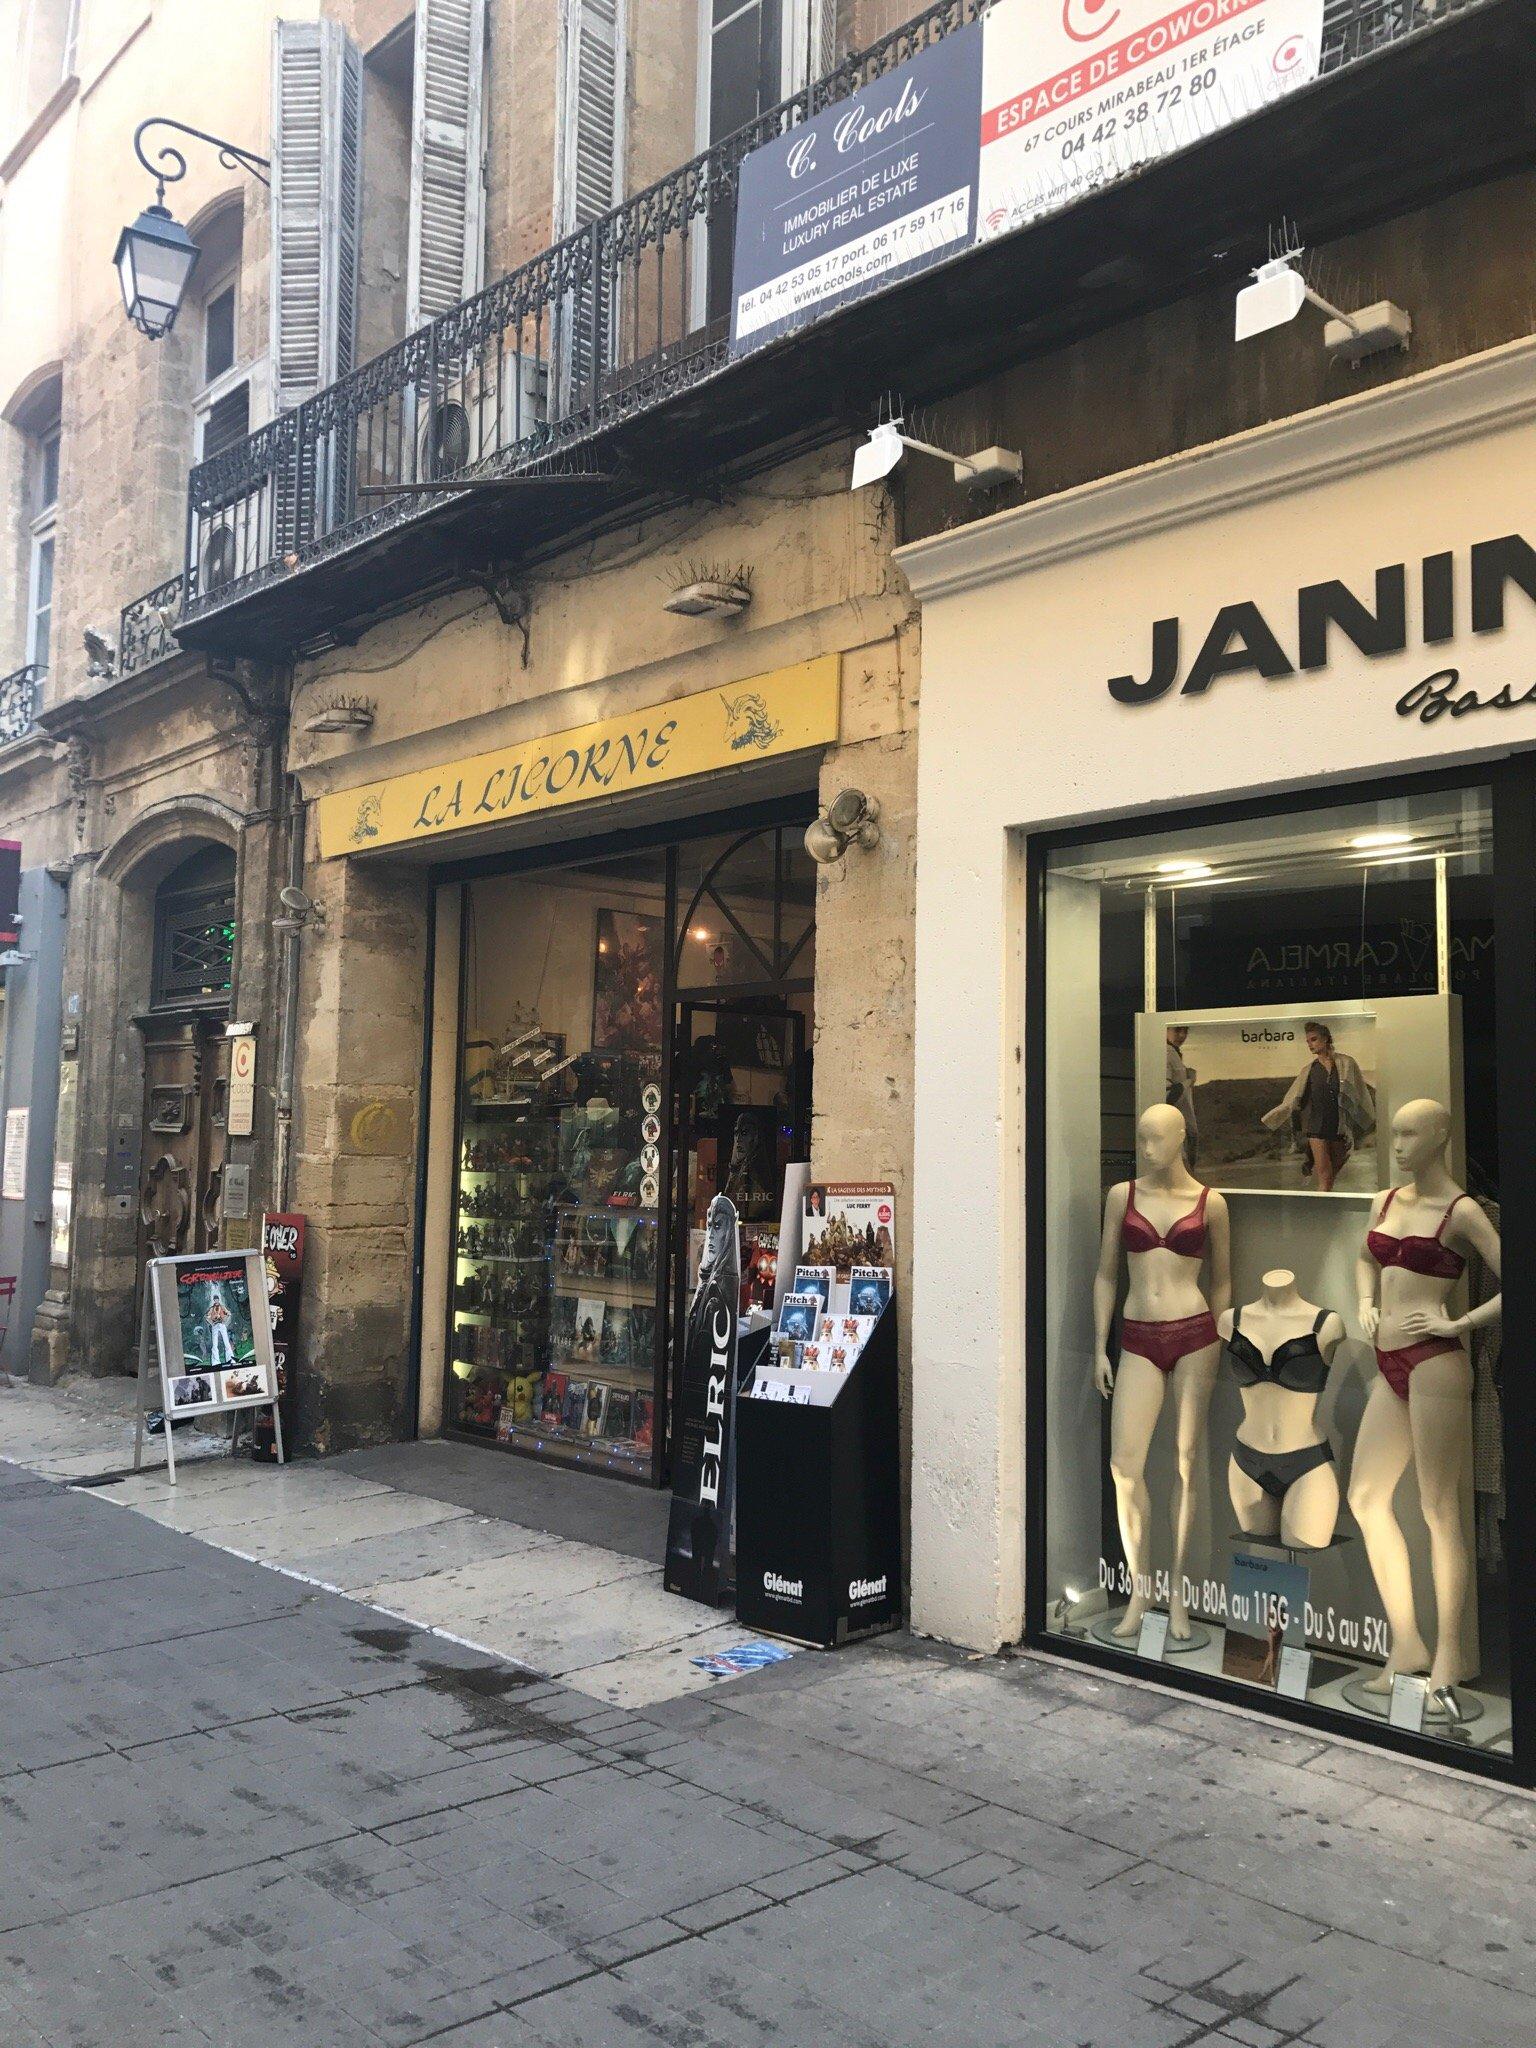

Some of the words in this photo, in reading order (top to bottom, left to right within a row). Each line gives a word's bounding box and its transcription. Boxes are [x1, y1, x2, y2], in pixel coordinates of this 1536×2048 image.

[997, 73, 1082, 132] ESPACE
[1089, 53, 1118, 81] DE
[1024, 133, 1040, 153] 67
[1044, 108, 1094, 142] COURS
[1097, 67, 1176, 117] MIRABEAU
[1181, 50, 1208, 74] 1ER
[1213, 18, 1265, 57] ÉTAGE
[1061, 137, 1085, 160] 04
[1091, 118, 1117, 143] 42
[1123, 101, 1149, 126] 38
[1156, 84, 1182, 113] 72
[1189, 67, 1217, 97] 80
[787, 133, 817, 179] C.
[834, 77, 928, 153] Cools
[783, 220, 829, 255] LUXURY
[833, 205, 865, 230] REAL
[868, 176, 918, 212] ESTATE
[784, 185, 857, 235] IMMOBILIER
[861, 178, 880, 195] DE
[883, 153, 919, 183] LUXE
[1048, 181, 1068, 199] WIFI
[741, 297, 757, 313] tél.
[760, 291, 772, 305] 04
[775, 281, 788, 298] 42
[791, 273, 804, 288] 53
[807, 266, 821, 281] 05
[825, 257, 839, 272] 17
[841, 245, 869, 268] port.
[873, 236, 888, 251] 06
[892, 225, 905, 241] 17
[909, 216, 925, 233] 59
[930, 206, 945, 222] 17
[950, 197, 965, 212] 16
[793, 251, 892, 306] www.ccools.com
[413, 779, 463, 829] LA
[474, 720, 677, 815] LICORNE
[1241, 1028, 1295, 1043] barbara
[736, 1192, 774, 1202] ELRIC
[784, 1295, 808, 1305] Pitch
[796, 1268, 820, 1278] Pitch
[852, 1268, 879, 1278] Pitch
[700, 1305, 731, 1510] ELRIC
[763, 1571, 803, 1598] Glénat
[849, 1575, 887, 1601] Glénat
[1234, 1556, 1268, 1572] barbara
[1100, 1558, 1115, 1591] Du
[1118, 1562, 1132, 1595] 36
[1136, 1573, 1151, 1599] au
[1155, 1570, 1169, 1603] 54
[1182, 1576, 1200, 1608] Du
[1203, 1580, 1228, 1616] 80A
[1232, 1594, 1249, 1621] au
[1254, 1590, 1289, 1631] 115G
[1304, 1602, 1323, 1638] Du
[1327, 1606, 1336, 1643] S
[1339, 1618, 1359, 1649] au
[1363, 1615, 1390, 1658] 5XL
